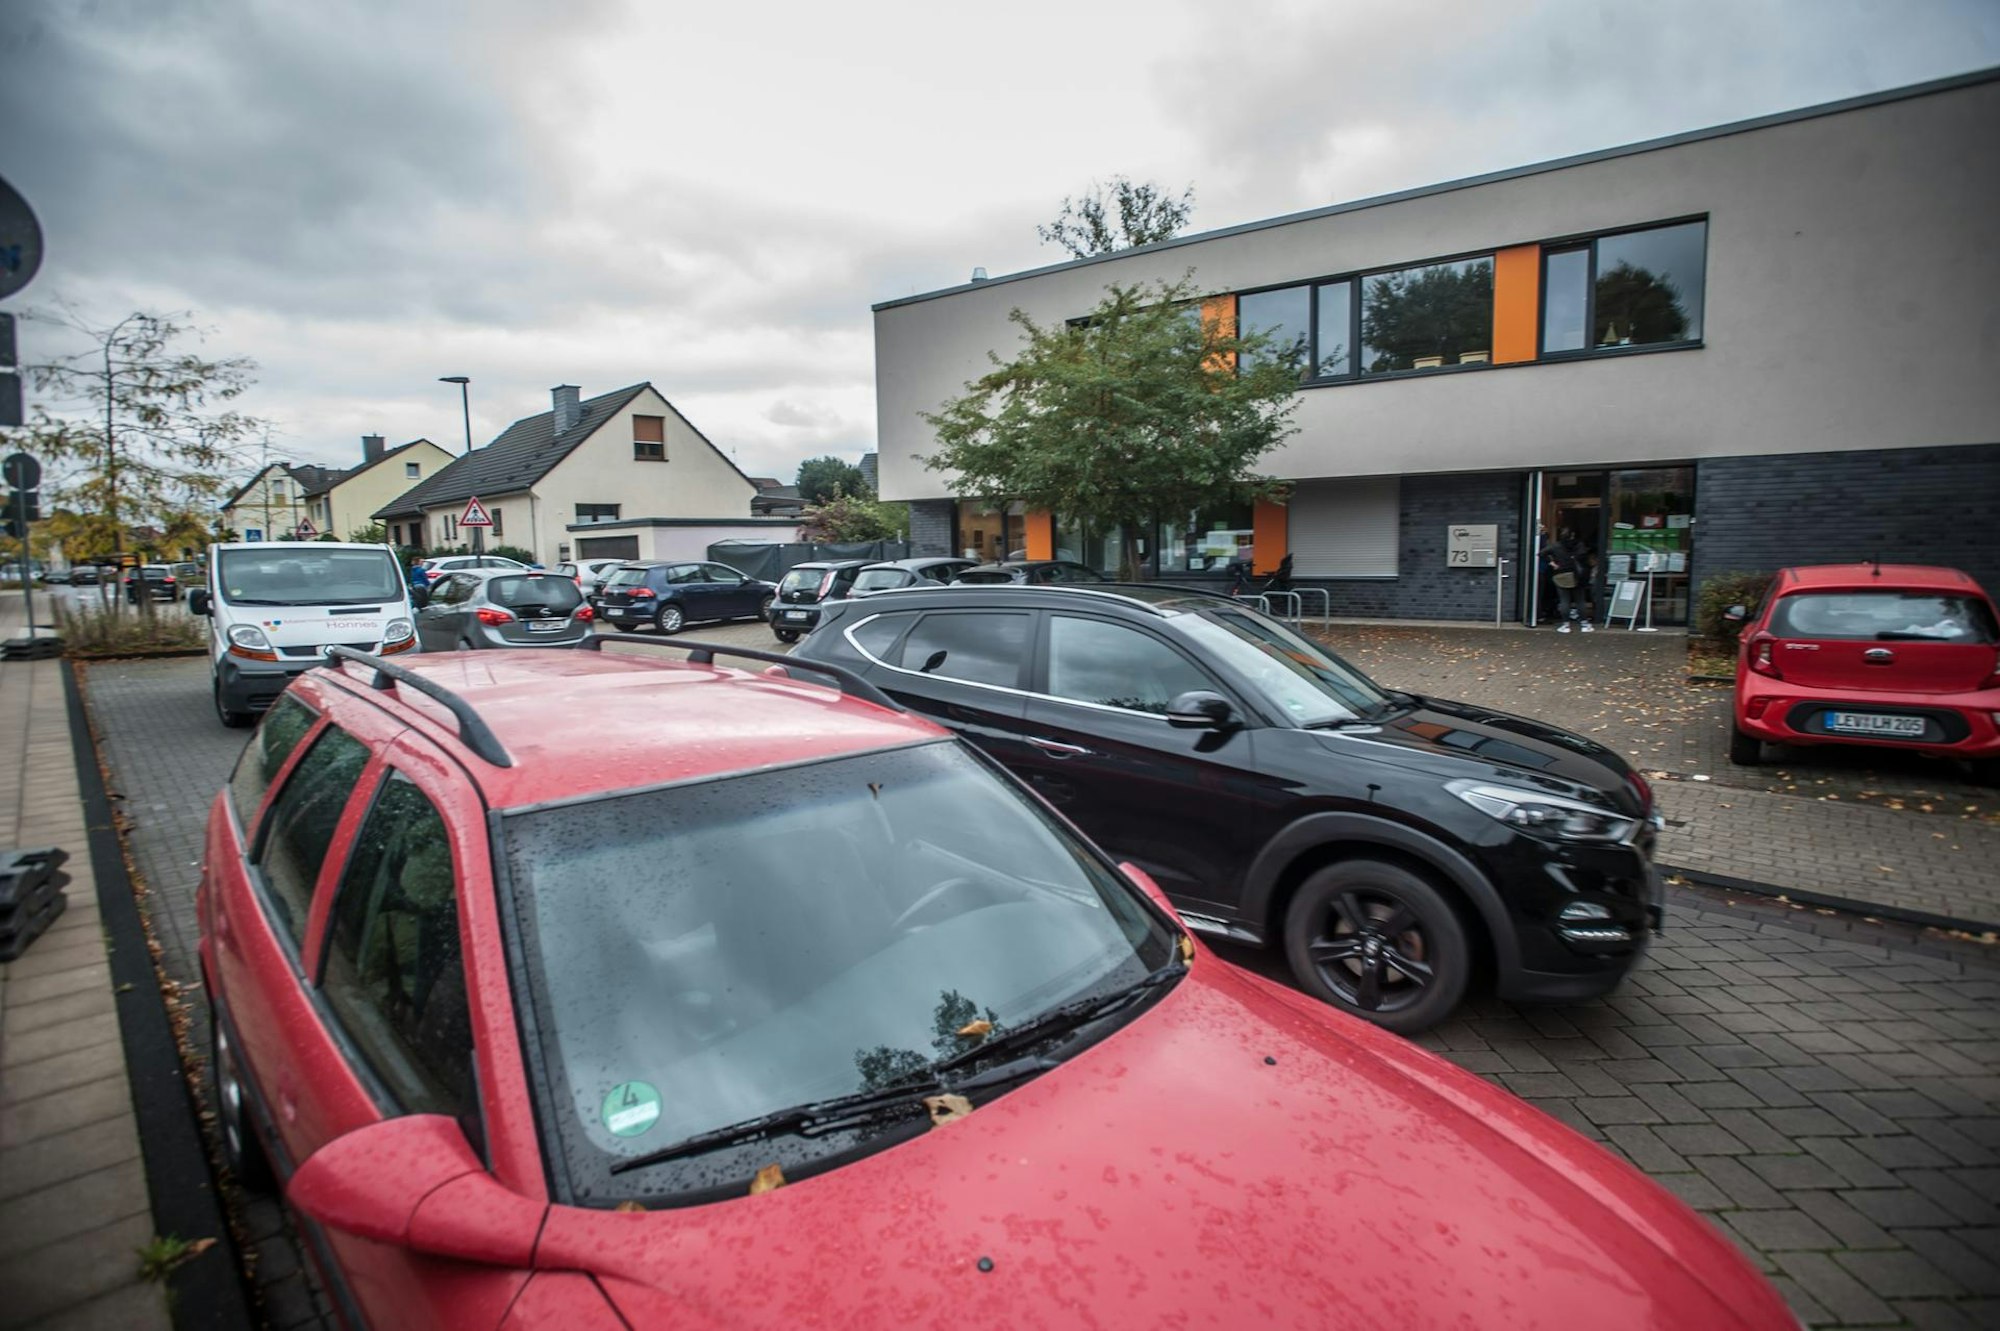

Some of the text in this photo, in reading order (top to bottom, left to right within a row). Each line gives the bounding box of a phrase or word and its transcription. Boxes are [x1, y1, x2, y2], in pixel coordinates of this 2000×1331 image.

[1451, 550, 1469, 563] 73
[1836, 714, 1922, 731] LEV LH 205
[622, 1084, 639, 1107] 4
